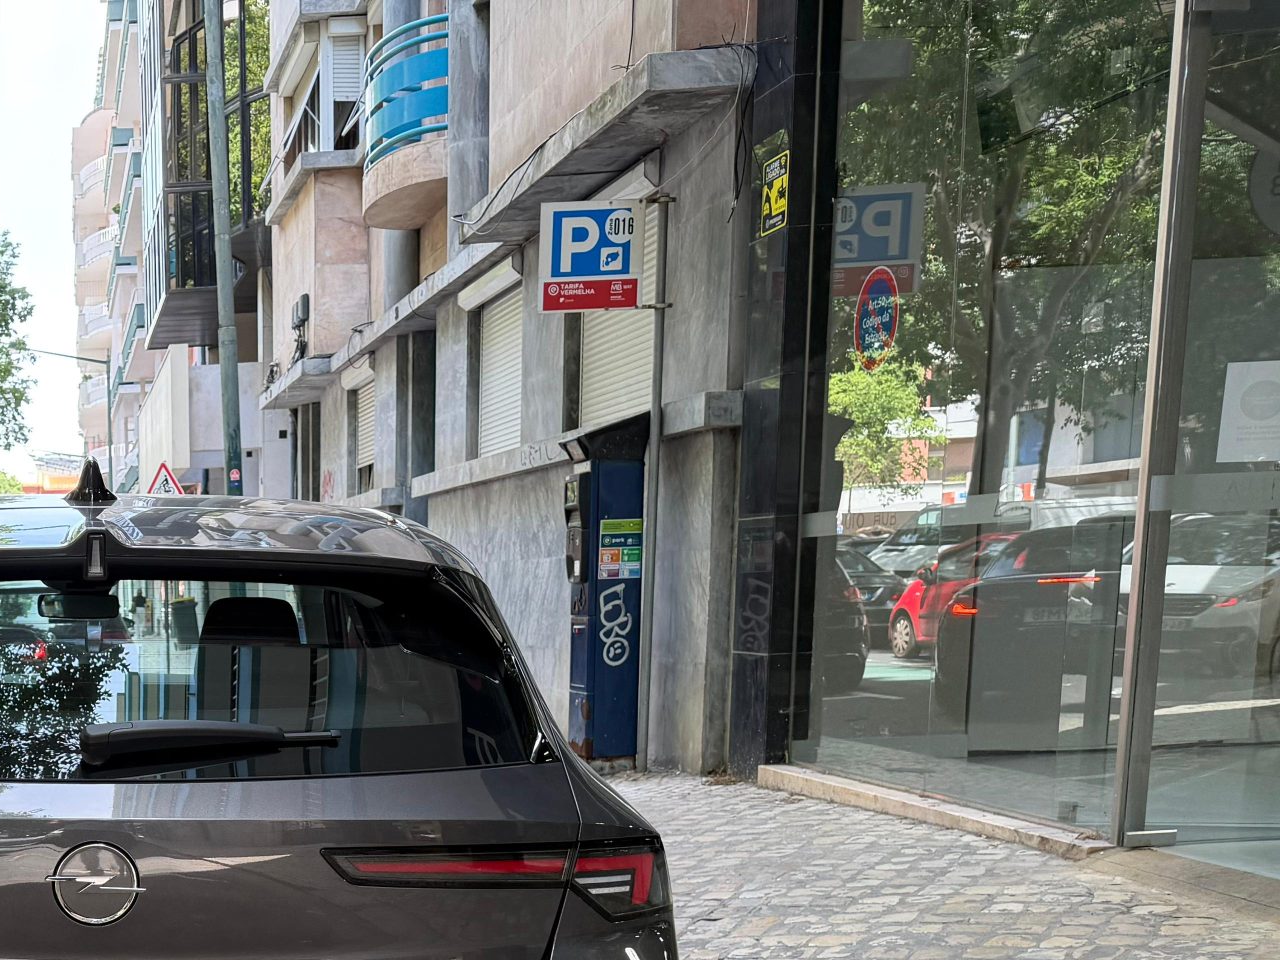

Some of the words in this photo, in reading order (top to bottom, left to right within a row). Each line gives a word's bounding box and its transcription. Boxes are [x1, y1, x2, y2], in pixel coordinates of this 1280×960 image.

[613, 217, 634, 236] 016
[560, 216, 600, 273] P
[862, 315, 882, 329] Código
[882, 310, 890, 322] da
